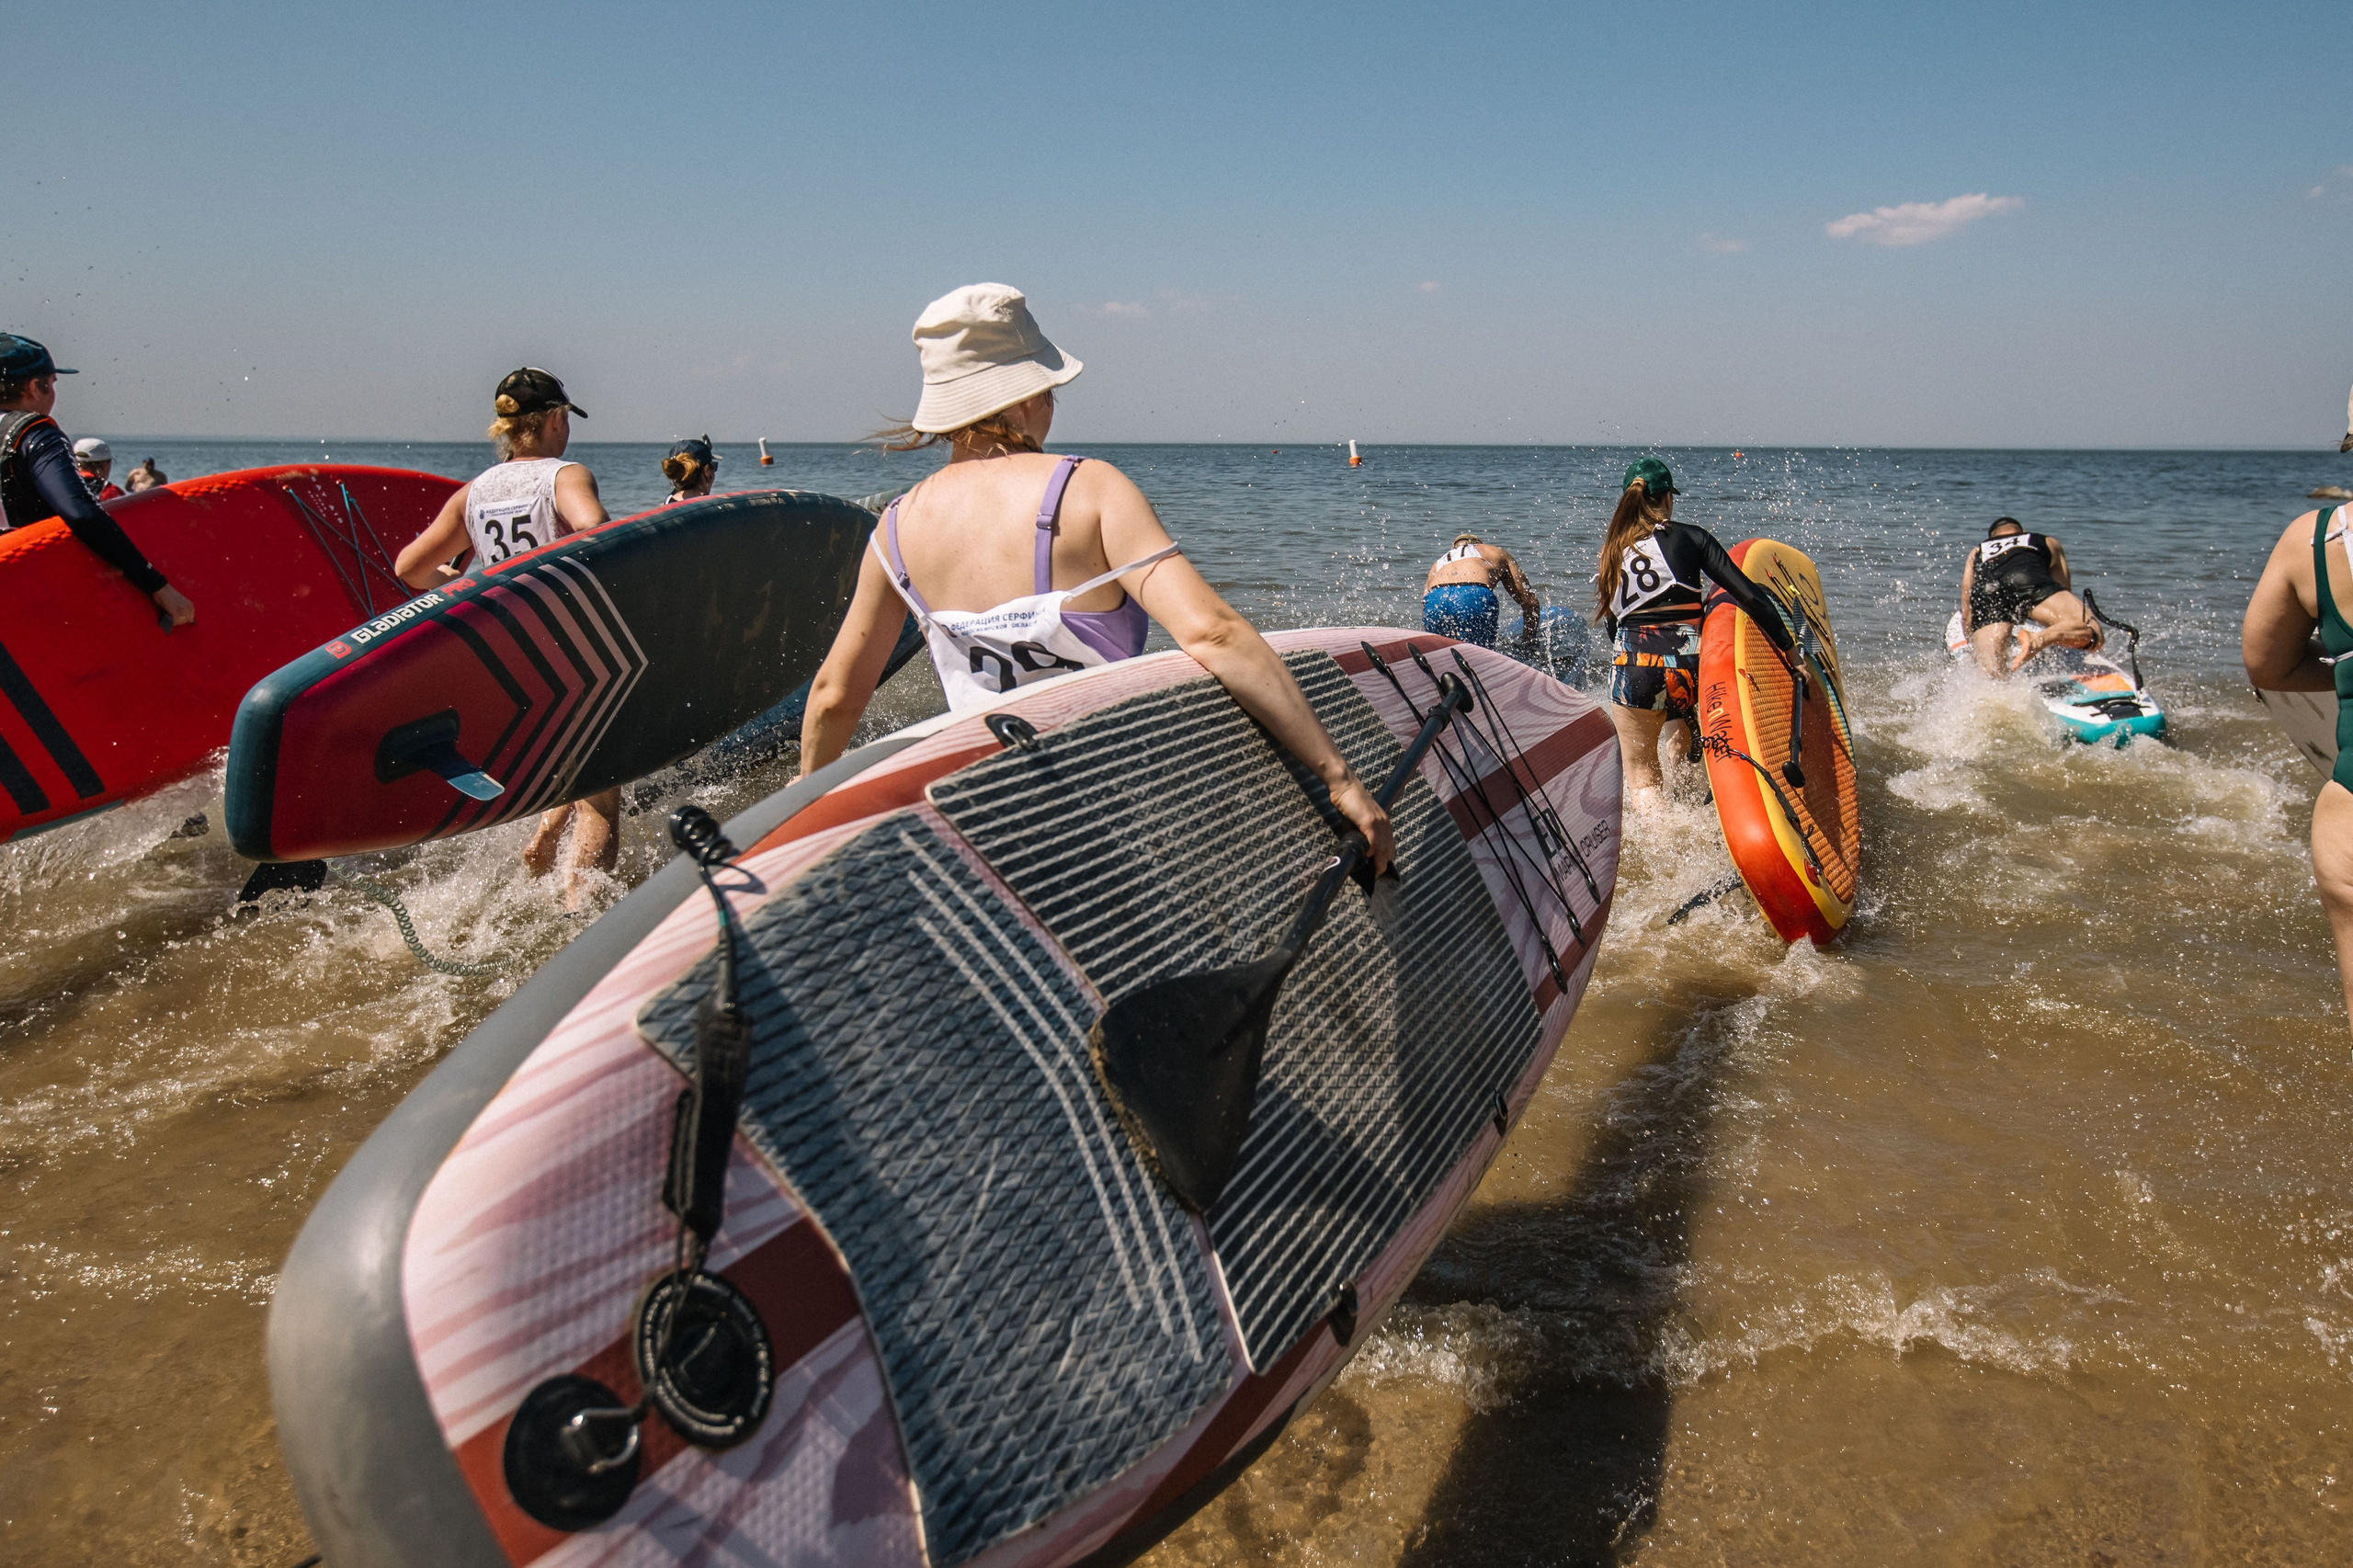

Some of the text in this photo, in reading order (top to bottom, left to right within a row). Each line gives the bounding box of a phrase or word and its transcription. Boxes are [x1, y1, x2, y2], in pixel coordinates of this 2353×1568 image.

[485, 514, 539, 562] 35
[1989, 538, 2020, 555] 34
[440, 578, 476, 597] PRO
[1620, 555, 1661, 610] 28
[950, 616, 1000, 631] ФЕДЕРАЦИЯ
[1579, 819, 1612, 858] CRUISER
